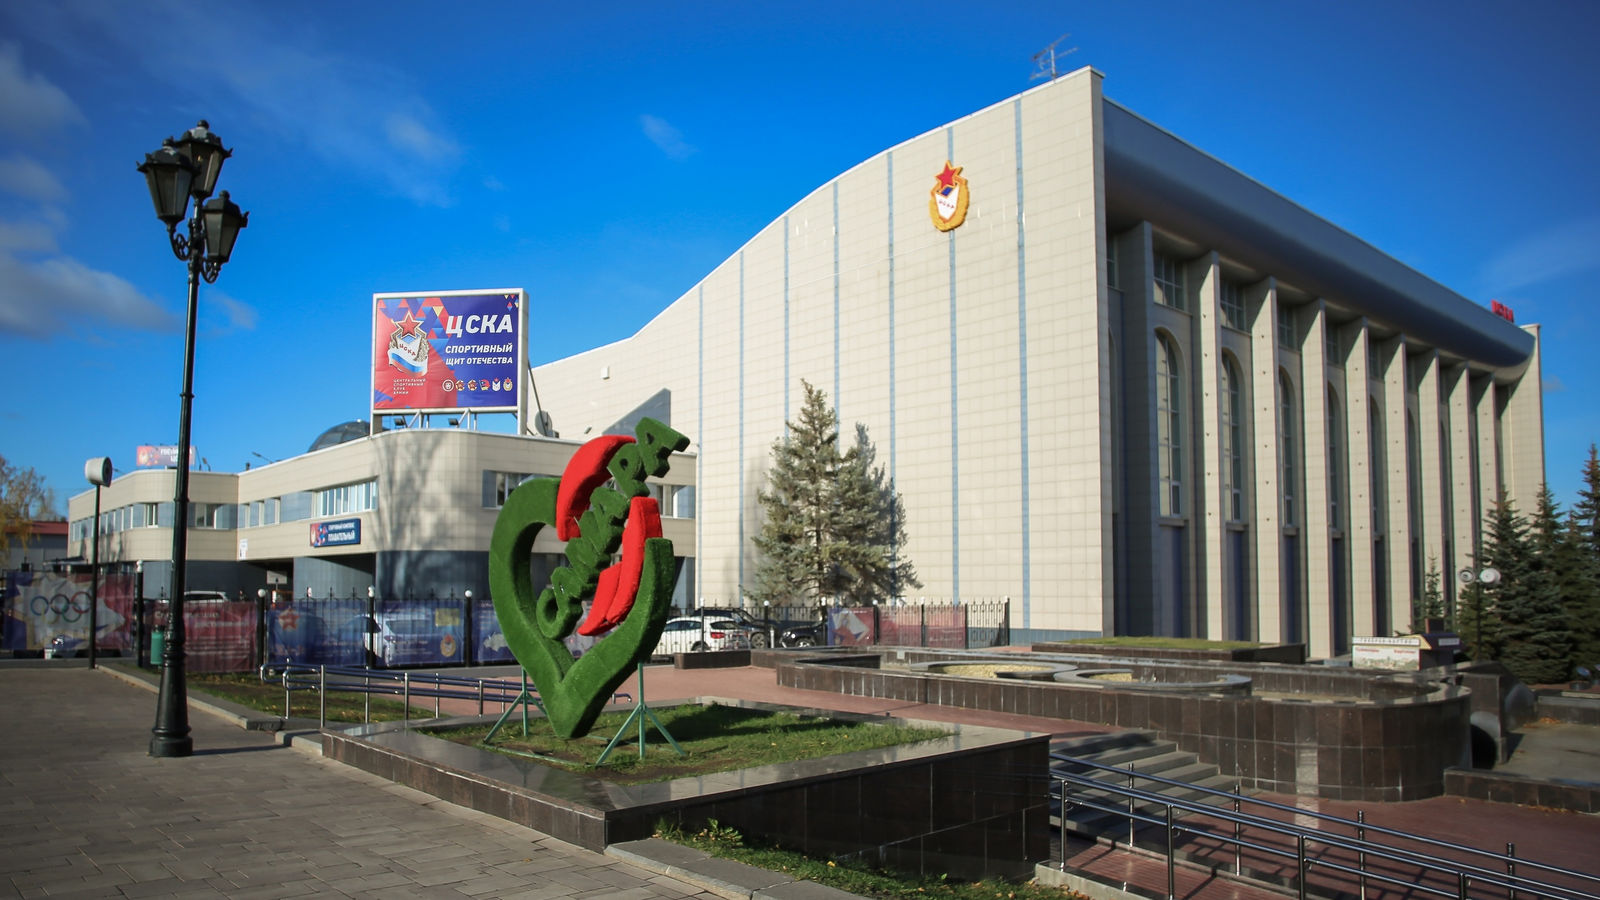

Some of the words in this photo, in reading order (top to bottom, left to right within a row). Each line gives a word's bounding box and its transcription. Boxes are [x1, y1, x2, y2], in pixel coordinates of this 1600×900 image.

[446, 314, 513, 338] ЦСКА
[445, 343, 513, 354] СПОРТИВНЫЙ
[466, 357, 513, 365] ОТЕЧЕСТВА
